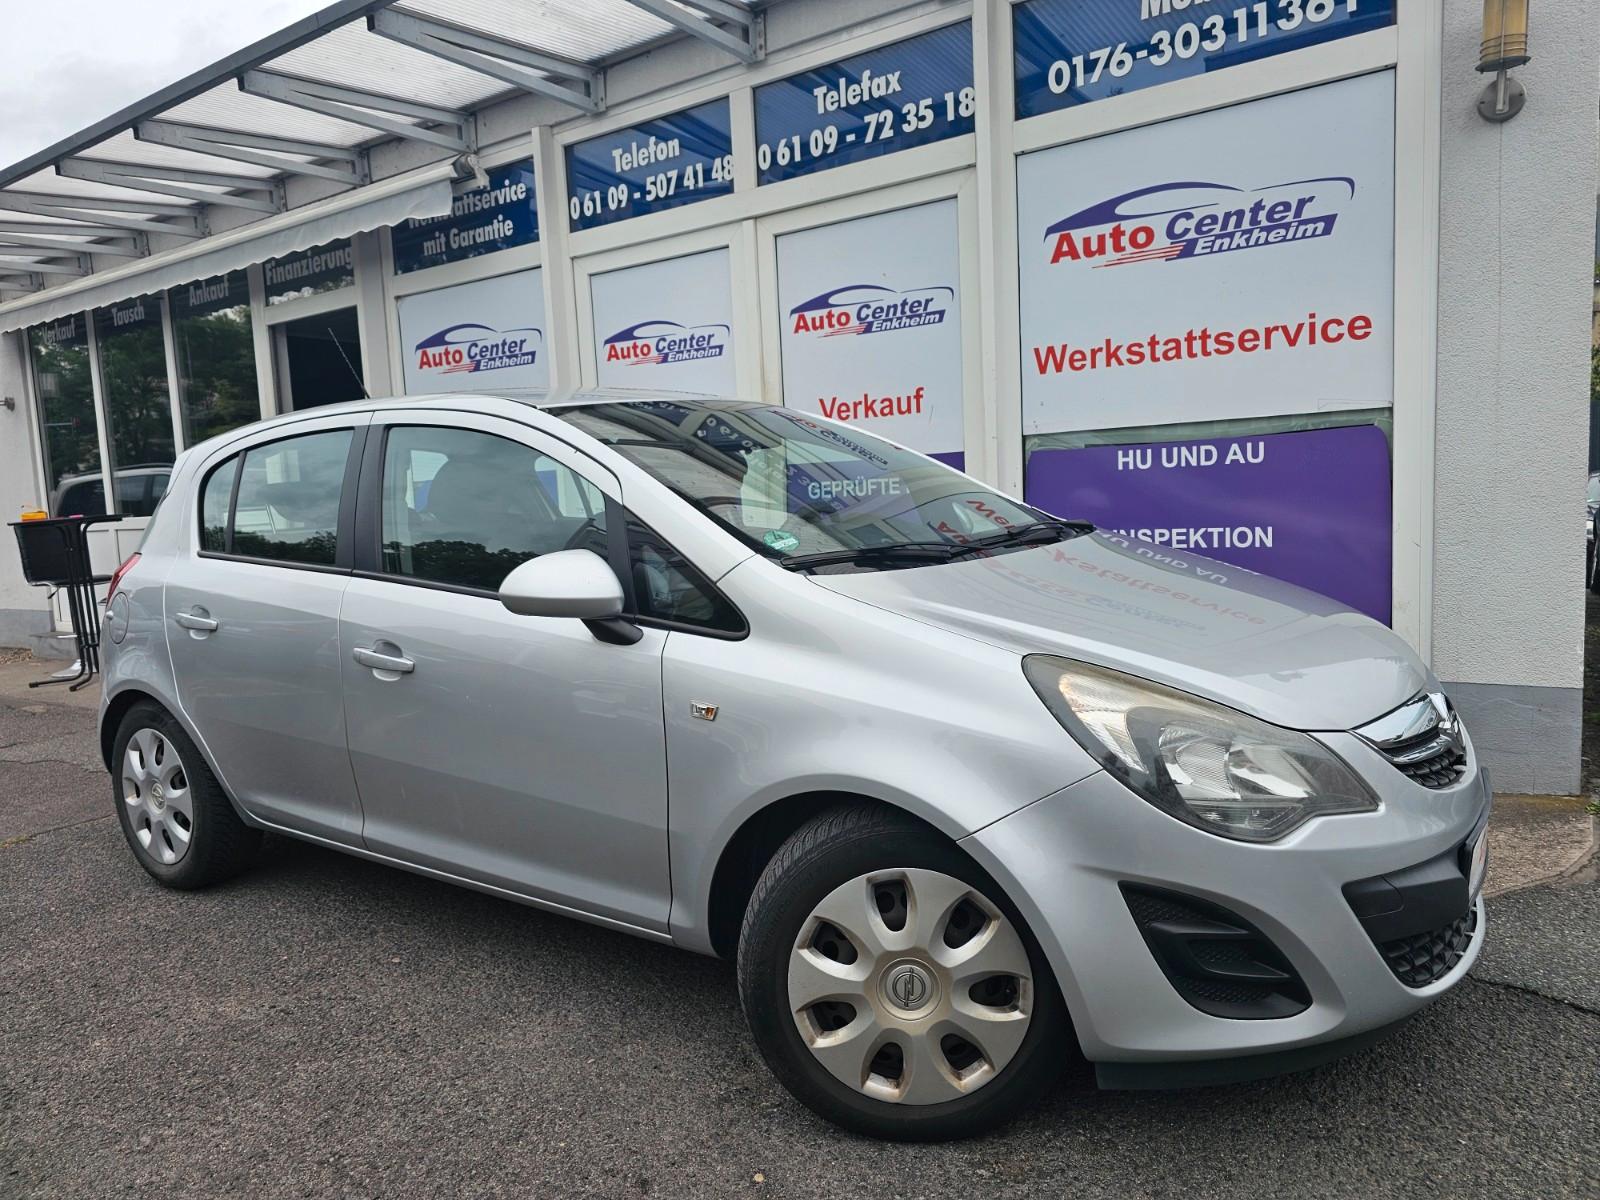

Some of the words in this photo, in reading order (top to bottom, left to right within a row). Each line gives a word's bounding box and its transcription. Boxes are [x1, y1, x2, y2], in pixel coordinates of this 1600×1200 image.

[813, 69, 902, 114] Telefax
[758, 143, 771, 170] 0
[776, 135, 801, 166] 61
[809, 125, 838, 158] 09
[864, 110, 894, 144] 72
[902, 98, 934, 133] 35
[944, 87, 976, 121] 18
[611, 135, 680, 173] Telefon
[570, 196, 580, 220] 0
[583, 191, 602, 217] 61
[607, 183, 628, 211] 09
[646, 169, 678, 201] 507
[683, 163, 703, 190] 41
[712, 154, 735, 183] 48
[423, 231, 446, 256] mit
[449, 214, 514, 250] Garantie
[1050, 222, 1155, 264] Auto
[1165, 195, 1316, 241] Center
[1193, 219, 1327, 256] Enkheim
[264, 246, 355, 286] Finanzierung
[188, 274, 230, 306] Ankauf
[111, 299, 145, 327] Tausch
[793, 309, 851, 334] Auto
[856, 297, 935, 322] Center
[871, 313, 940, 333] Enkheim
[419, 346, 464, 369] Auto
[467, 337, 528, 360] Center
[606, 341, 652, 362] Auto
[655, 332, 715, 354] Center
[667, 346, 720, 363] Enkheim
[1033, 312, 1373, 375] Werkstattservice
[480, 352, 533, 370] Enkheim
[818, 387, 925, 421] Verkauf
[1118, 448, 1152, 470] HU
[1161, 445, 1218, 468] UND
[1224, 441, 1265, 465] AU
[807, 475, 901, 500] GEPRÜFTE
[1112, 526, 1273, 550] SPEKTION
